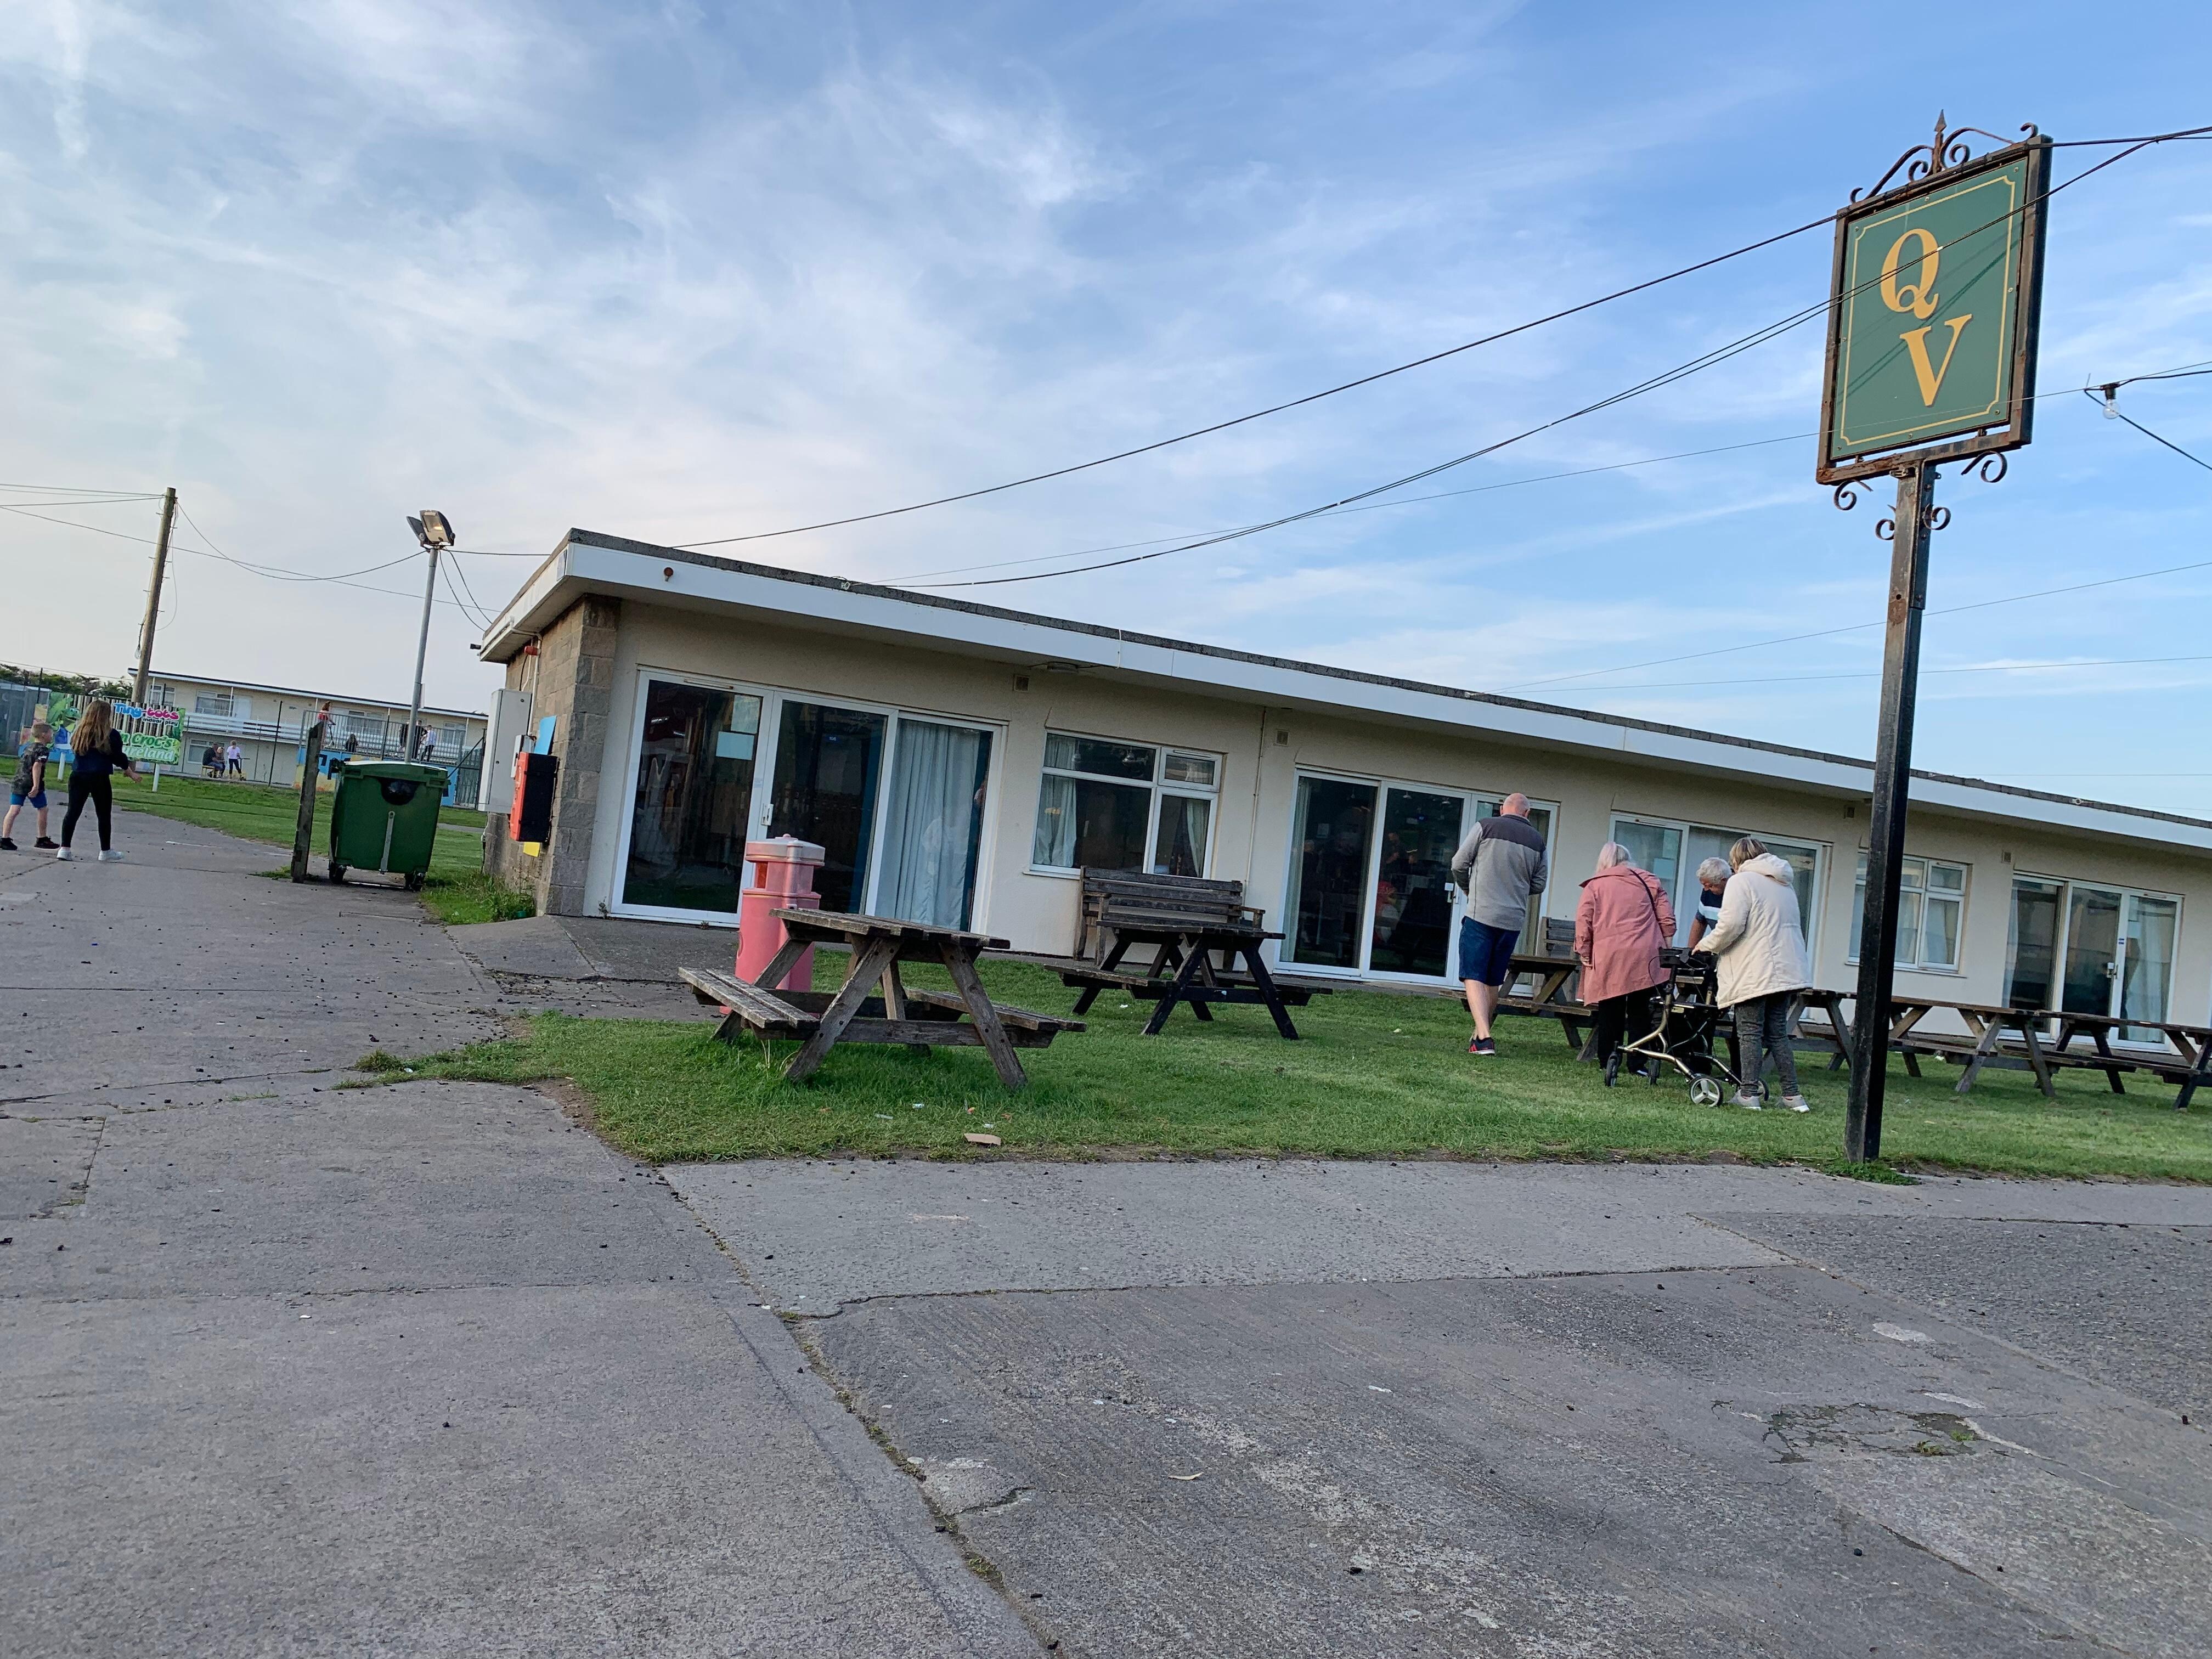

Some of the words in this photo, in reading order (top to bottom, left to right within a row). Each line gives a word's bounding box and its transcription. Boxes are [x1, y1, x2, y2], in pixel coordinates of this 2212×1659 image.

[1881, 228, 1939, 319] Q
[1900, 314, 1972, 405] V
[122, 747, 174, 760] ureland
[132, 733, 172, 746] Croc's
